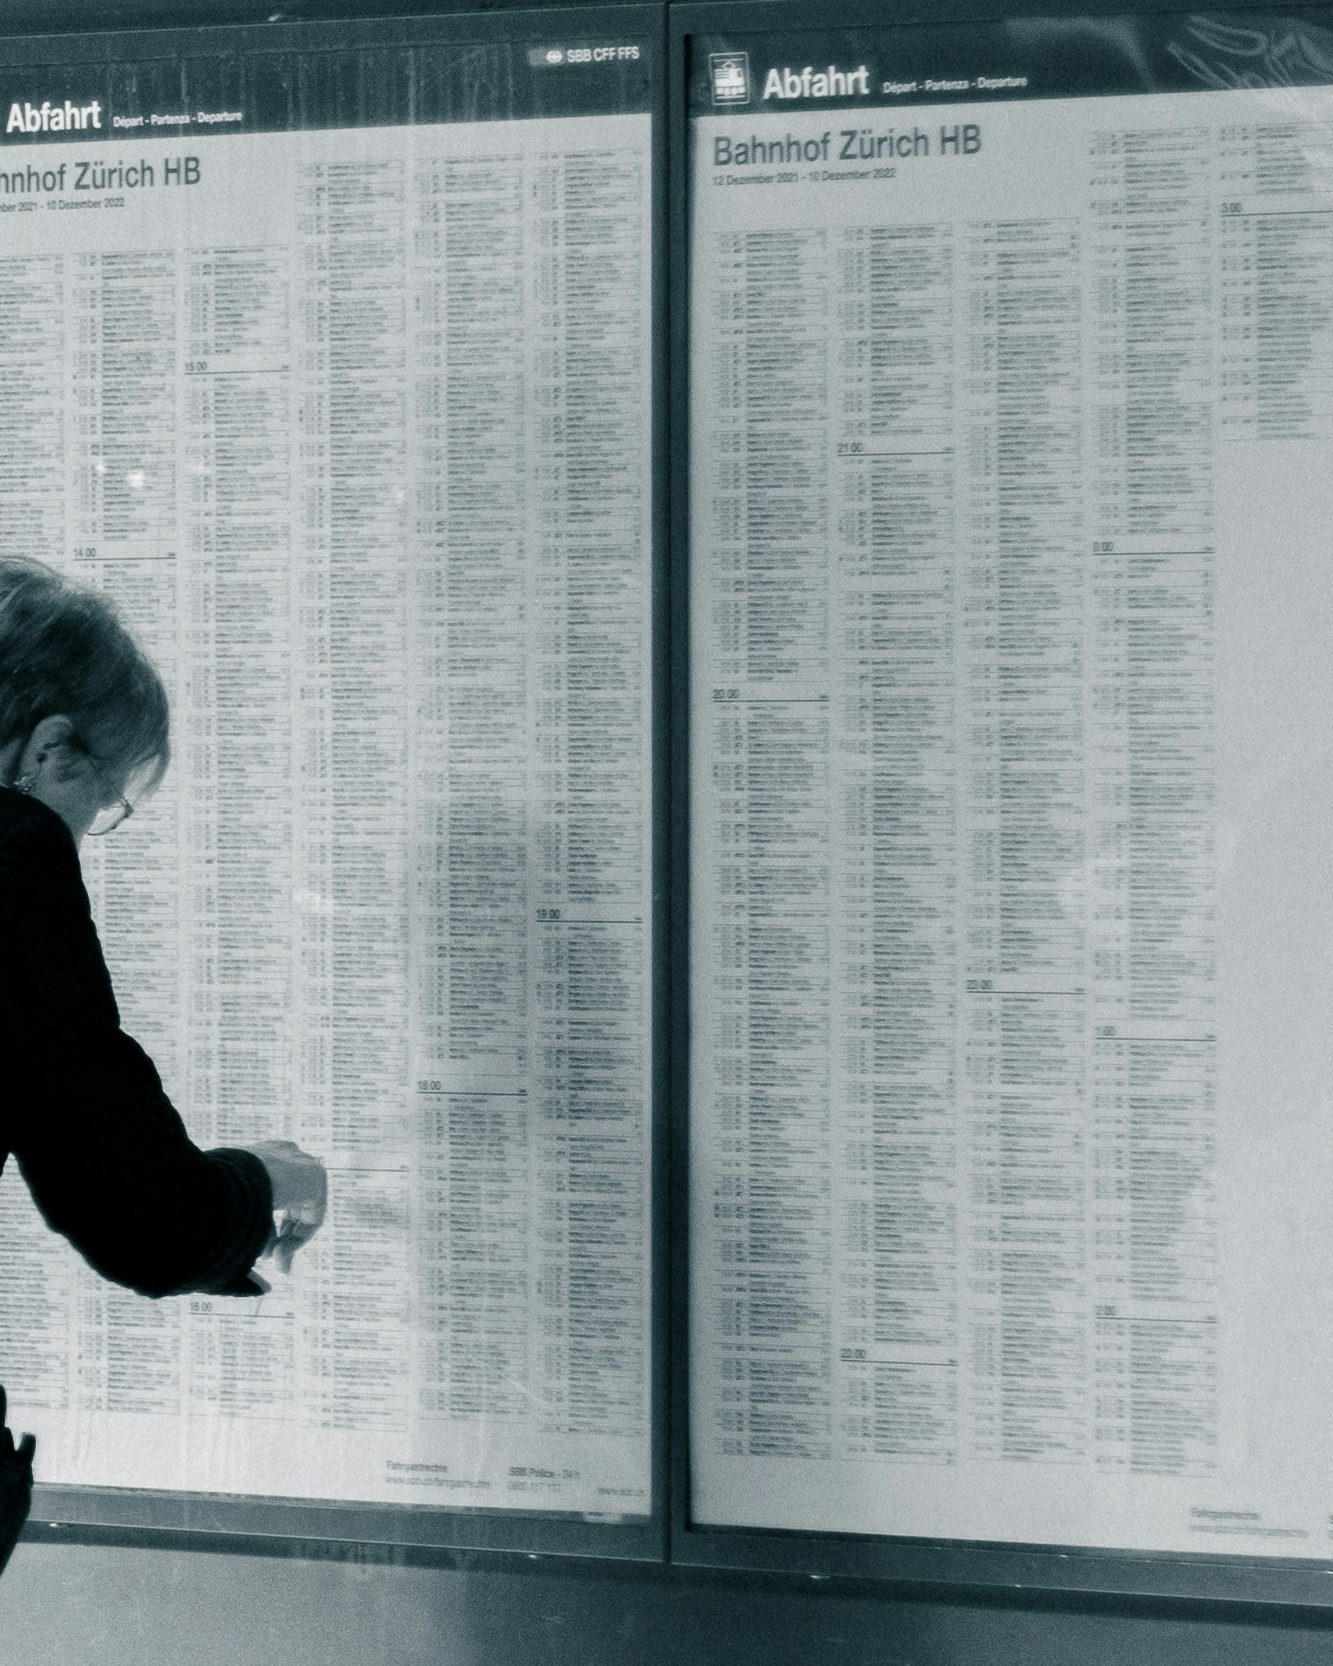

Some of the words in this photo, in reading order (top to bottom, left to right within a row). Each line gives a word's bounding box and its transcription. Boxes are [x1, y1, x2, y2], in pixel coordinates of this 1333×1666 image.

[567, 48, 592, 63] SBB
[593, 47, 616, 61] CFF
[617, 46, 640, 60] FFS
[763, 65, 870, 100] Abfahrt
[5, 100, 102, 133] Abfahrt
[713, 131, 831, 166] Bahnhof
[839, 128, 930, 161] Zürich
[939, 124, 982, 155] HB
[74, 159, 154, 191] Zürich
[164, 156, 201, 185] HB
